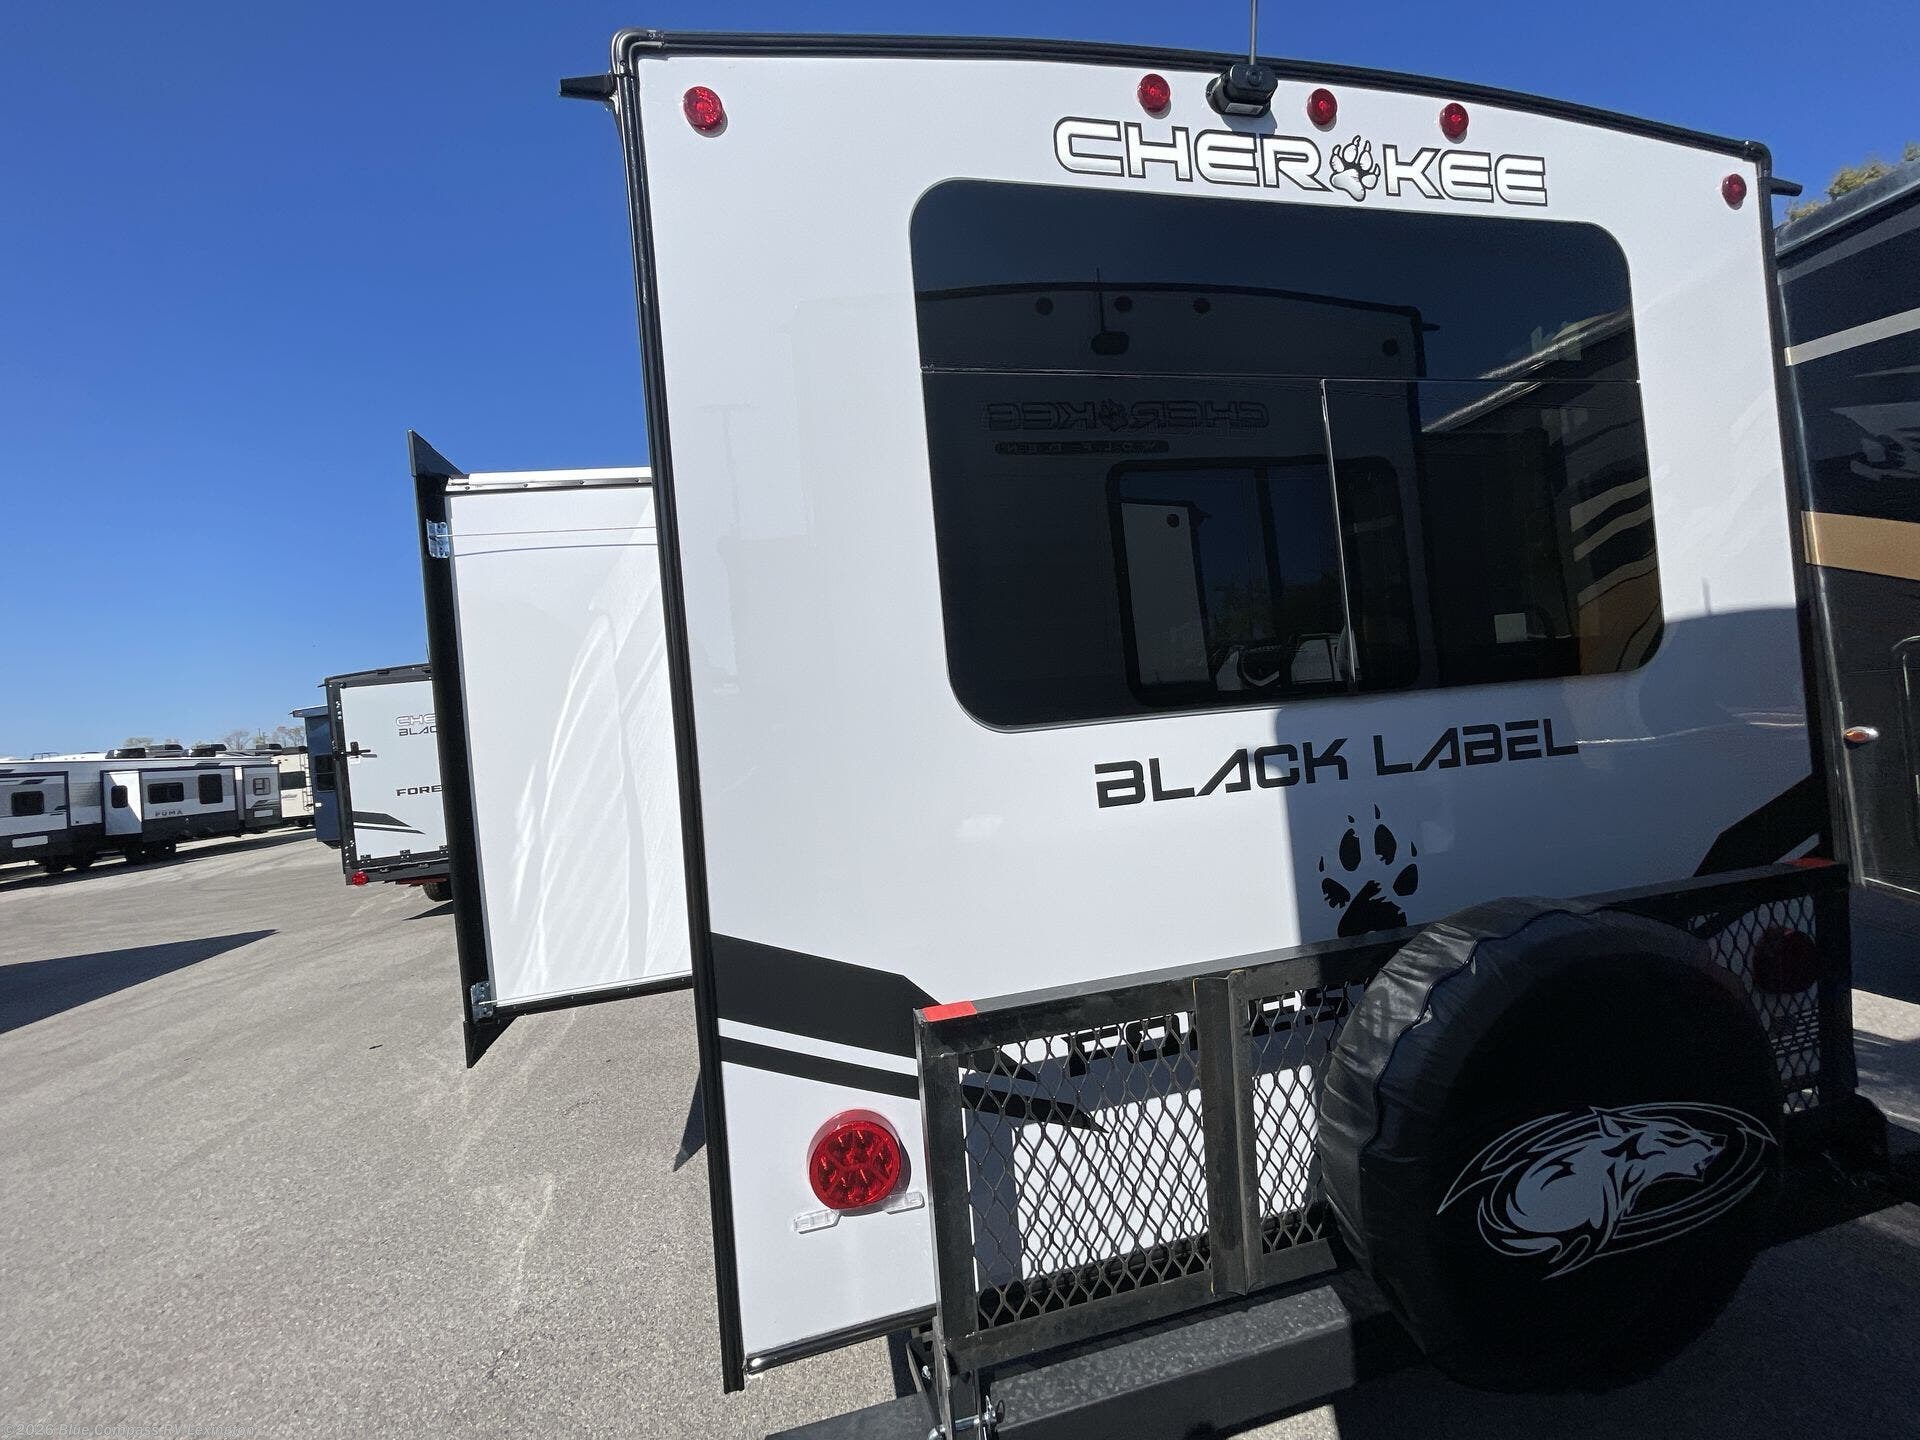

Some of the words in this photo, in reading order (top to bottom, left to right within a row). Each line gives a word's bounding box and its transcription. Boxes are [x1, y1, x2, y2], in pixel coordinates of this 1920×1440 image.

[1094, 737, 1349, 809] BLACK
[1373, 718, 1580, 776] LABEL
[155, 810, 183, 818] PUMA
